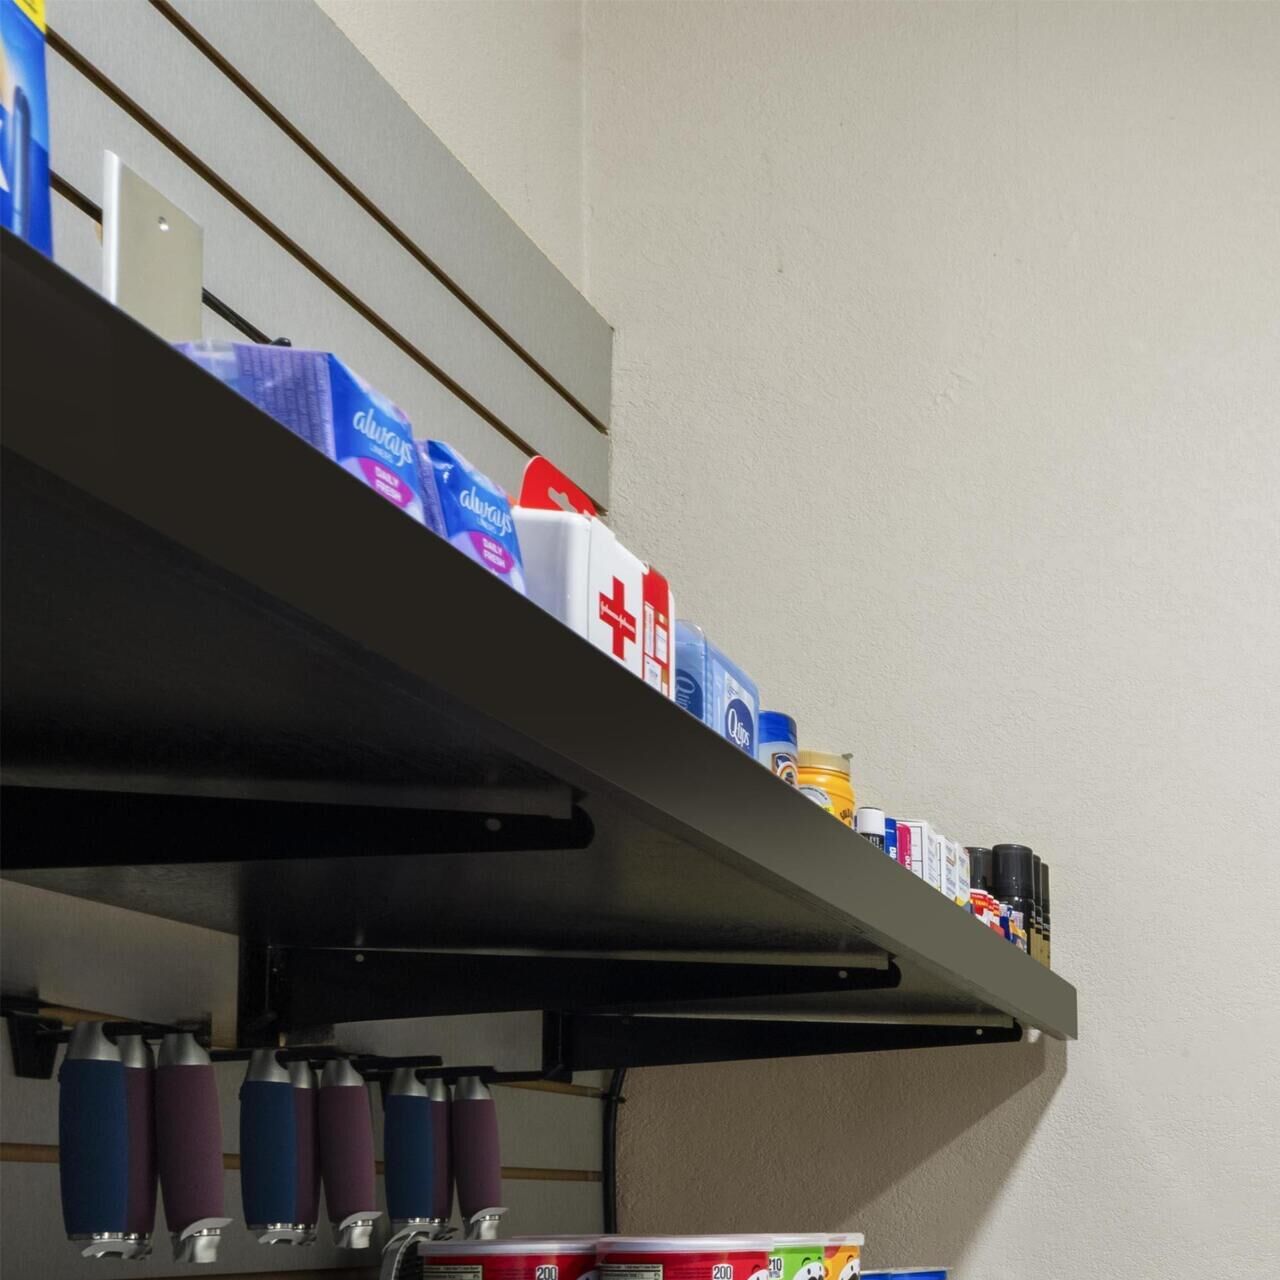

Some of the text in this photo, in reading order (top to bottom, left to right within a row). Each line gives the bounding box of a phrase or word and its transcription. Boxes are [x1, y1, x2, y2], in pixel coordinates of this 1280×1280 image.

[353, 408, 413, 467] always
[460, 487, 512, 537] always
[537, 1266, 557, 1280] 200
[714, 1265, 732, 1280] 200
